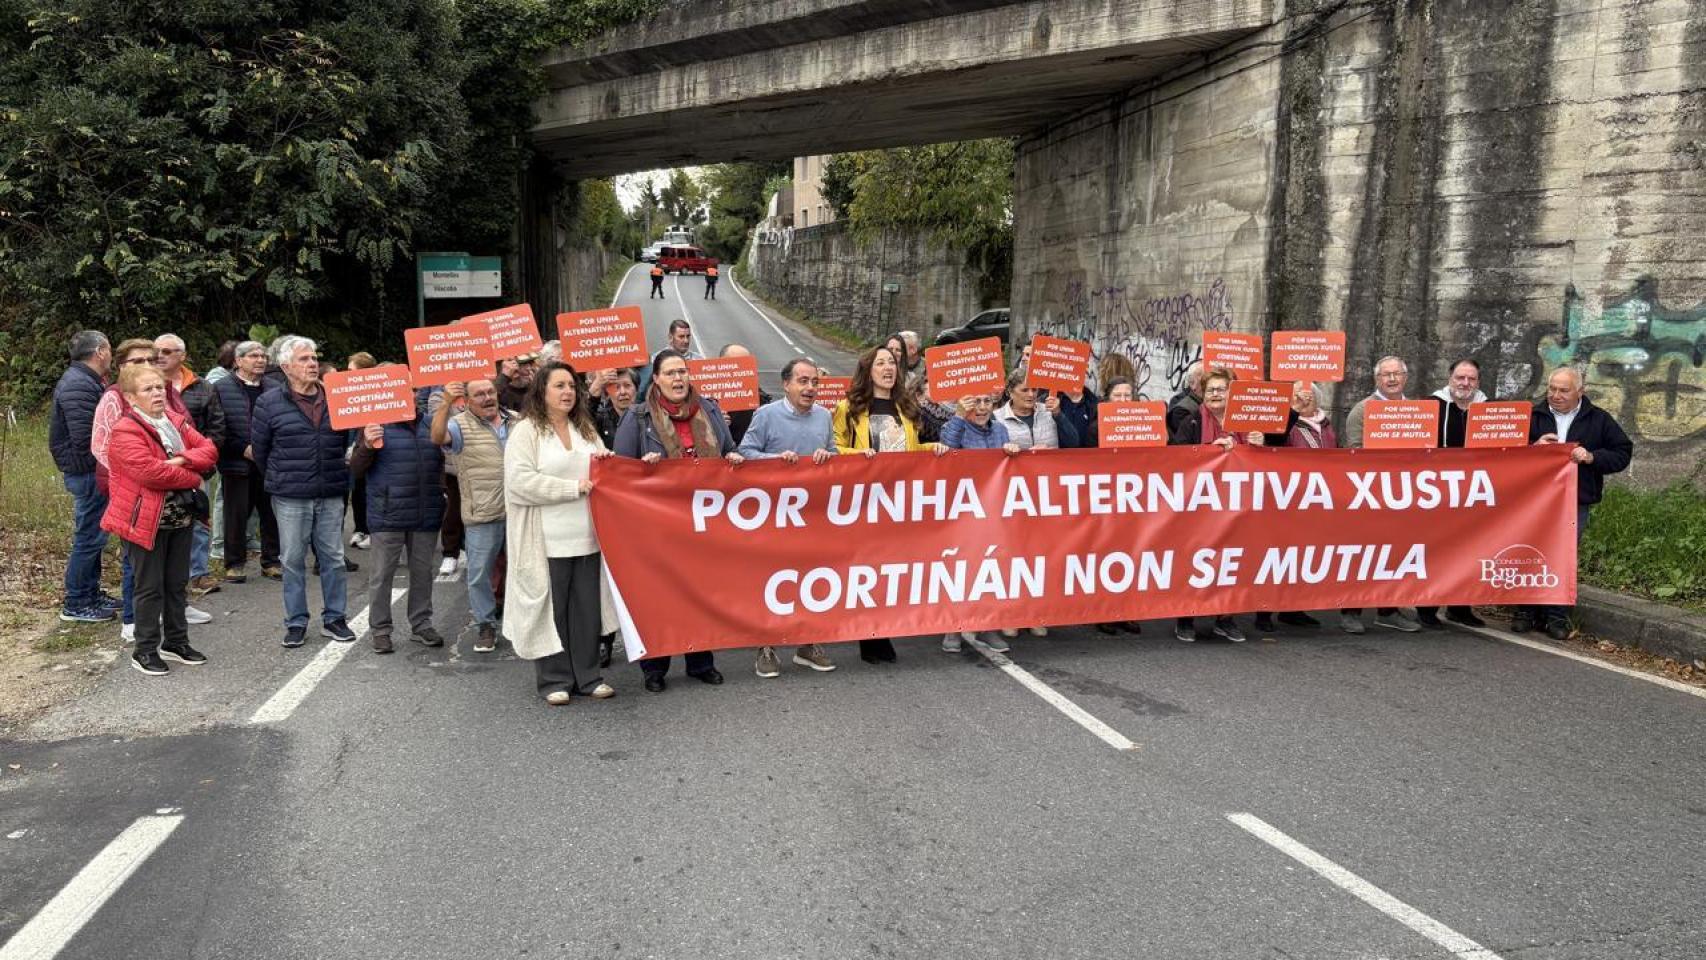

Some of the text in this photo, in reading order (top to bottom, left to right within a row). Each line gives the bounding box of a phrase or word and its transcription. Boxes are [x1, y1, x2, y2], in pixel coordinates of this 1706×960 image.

[564, 326, 613, 337] ALTERNATIVA
[414, 341, 463, 352] ALTERNATIVA
[570, 350, 592, 359] NON
[606, 343, 639, 354] MUTILA
[1034, 349, 1068, 359] ALTERNATIVA
[420, 364, 441, 373] NON
[456, 360, 489, 369] MUTILA
[932, 356, 975, 368] ALTERNATIVA
[937, 372, 998, 389] NON SE MUTILA
[1032, 368, 1048, 377] NON
[1058, 373, 1080, 382] MUTILA
[332, 383, 381, 394] ALTERNATIVA
[724, 389, 753, 398] MUTILA
[338, 400, 407, 416] NON SE MUTILA
[692, 470, 1496, 532] POR UNHA ALTERNATIVA XUSTA
[764, 543, 1428, 616] CORTIÑÁN NON SE MUTILA
[1479, 559, 1559, 590] Bergondo
